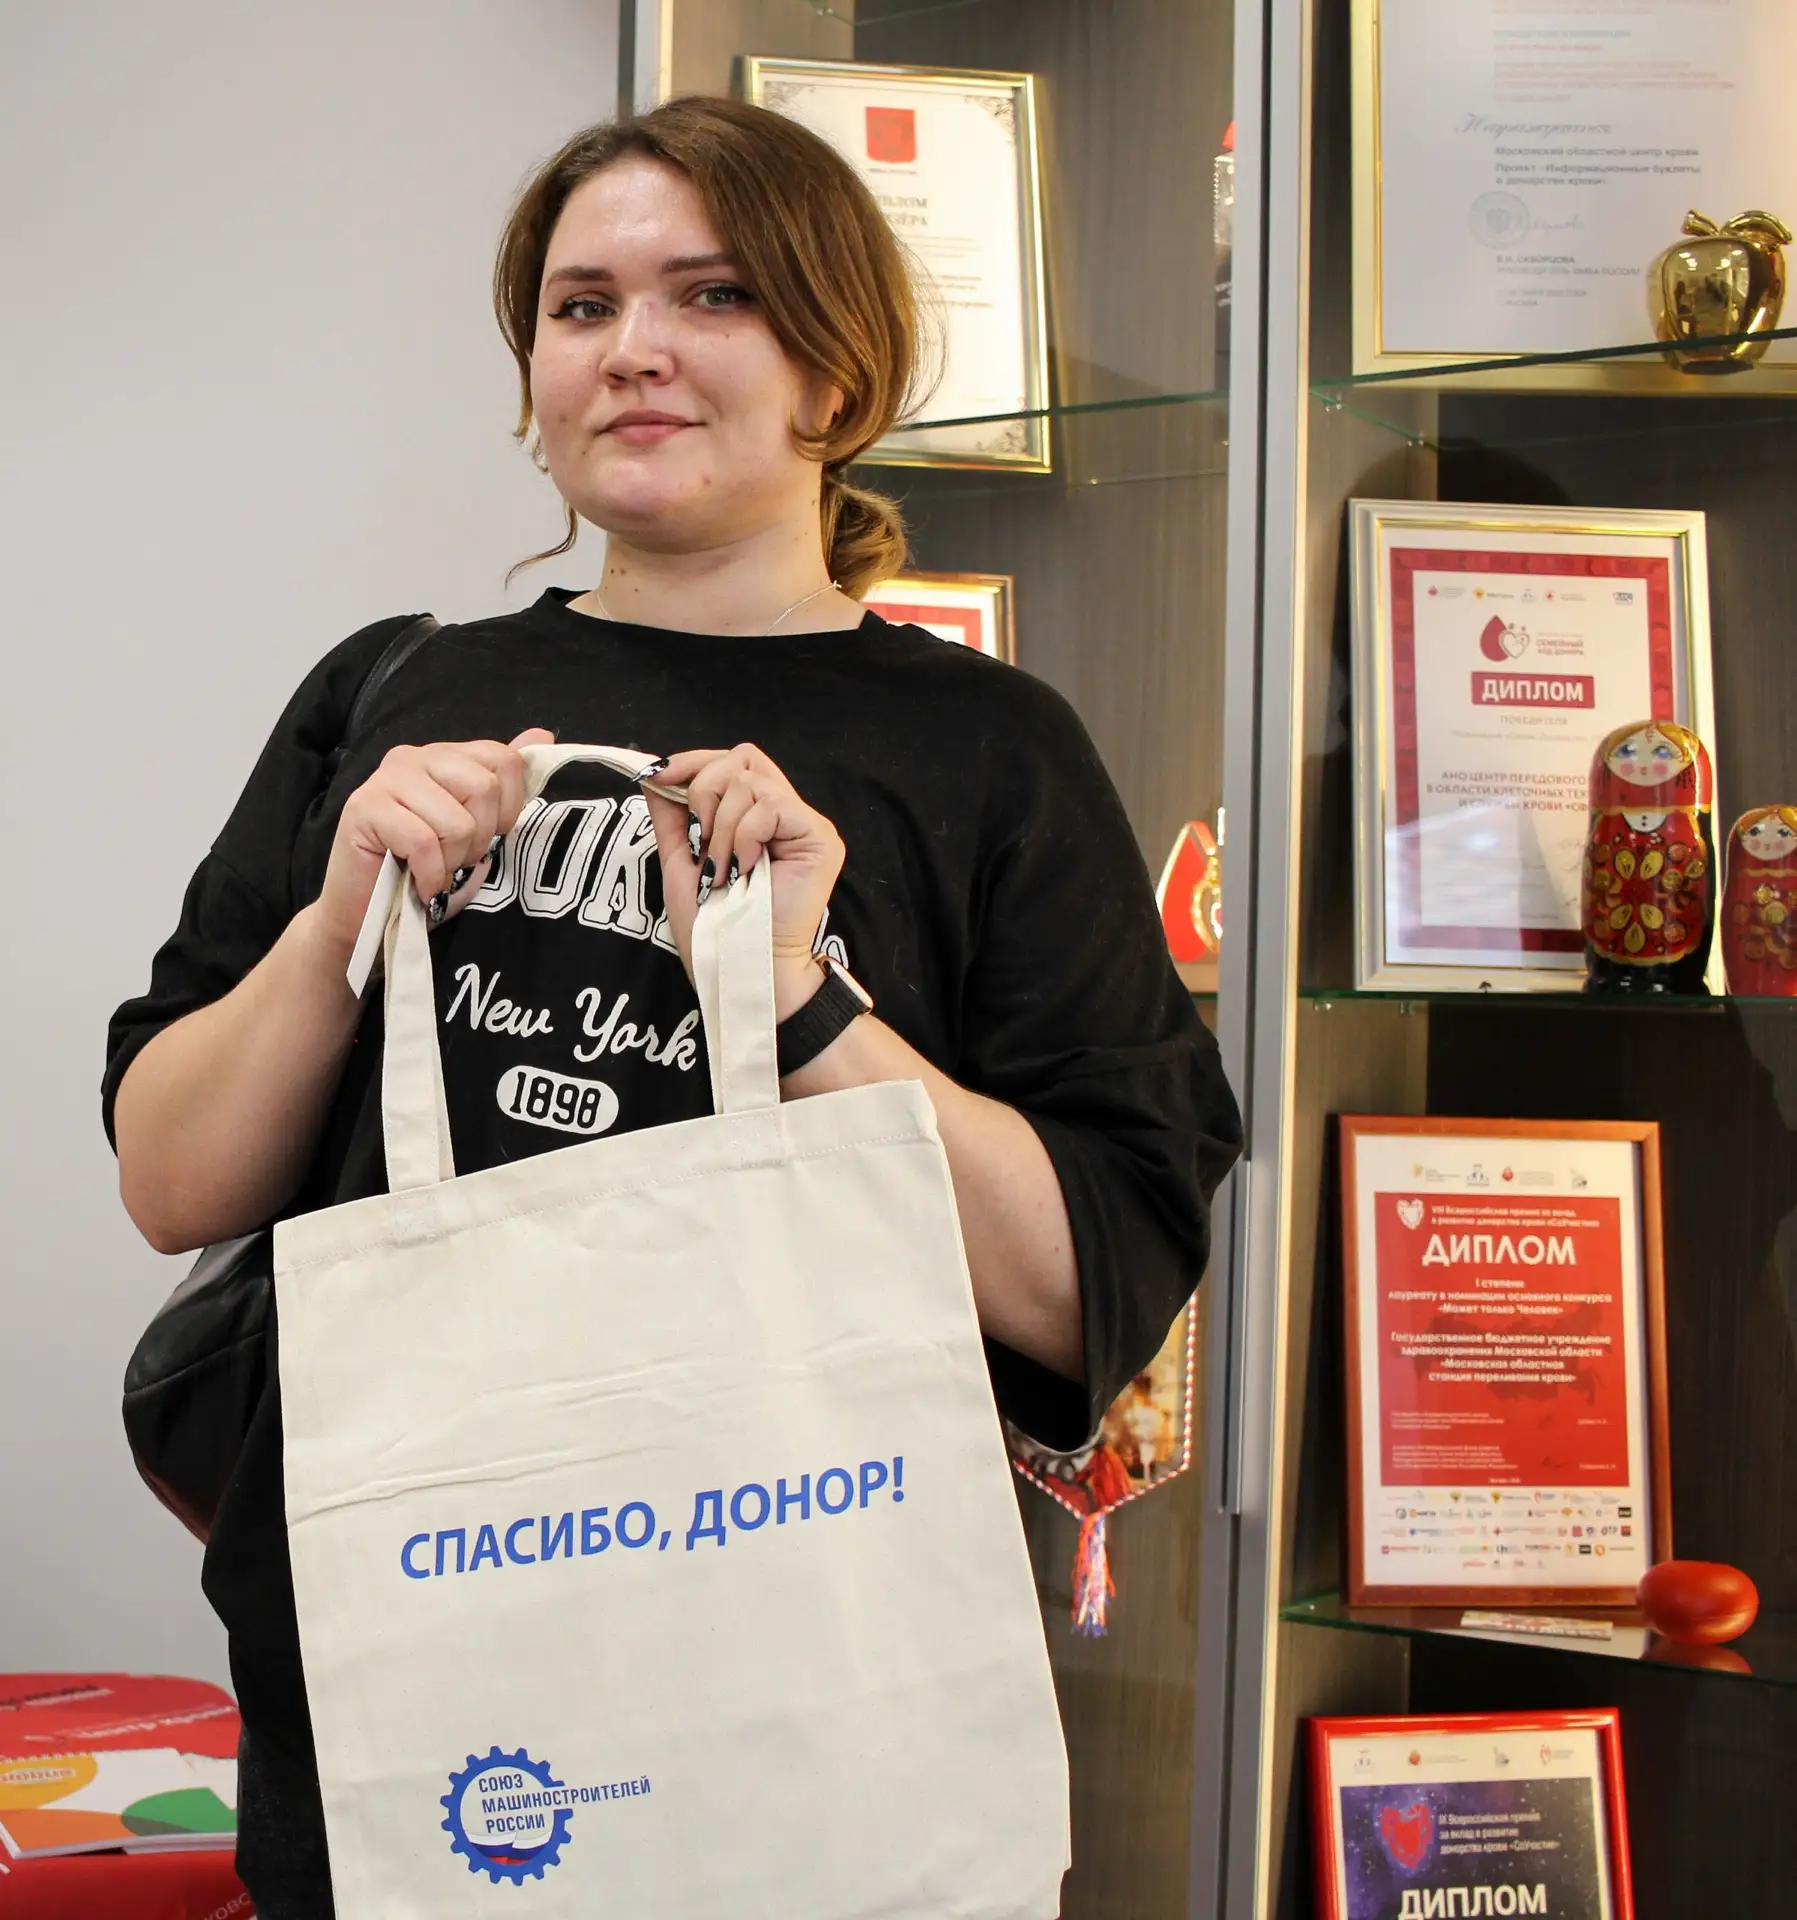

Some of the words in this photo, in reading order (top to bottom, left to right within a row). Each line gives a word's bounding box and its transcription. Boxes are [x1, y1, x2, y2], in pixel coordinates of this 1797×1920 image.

[1481, 678, 1584, 703] ДИПЛОМ
[1435, 784, 1491, 795] ОБЛАСТИ
[1493, 786, 1564, 797] КЛЕТОЧНЫХ
[1441, 771, 1467, 782] АНО
[1469, 772, 1507, 783] ЦЕНТР
[1510, 773, 1587, 785] ПЕРЕДОВОГО
[1522, 802, 1563, 812] КРОВИ
[445, 962, 553, 1037] New
[573, 987, 699, 1071] York
[509, 1071, 602, 1129] 1898
[1421, 1233, 1577, 1267] ДИПЛОМ
[1508, 1292, 1561, 1302] основного
[1563, 1293, 1613, 1304] конкурса
[400, 1501, 673, 1580] СПАСИБО,
[686, 1456, 905, 1551] ДОНОР!
[478, 1773, 524, 1793] СОЮЗ
[482, 1775, 651, 1814] МАШИНОСТРОИТЕЛЕЙ
[486, 1813, 545, 1833] РОССИИ
[1398, 1883, 1547, 1920] ДИПЛОМ
